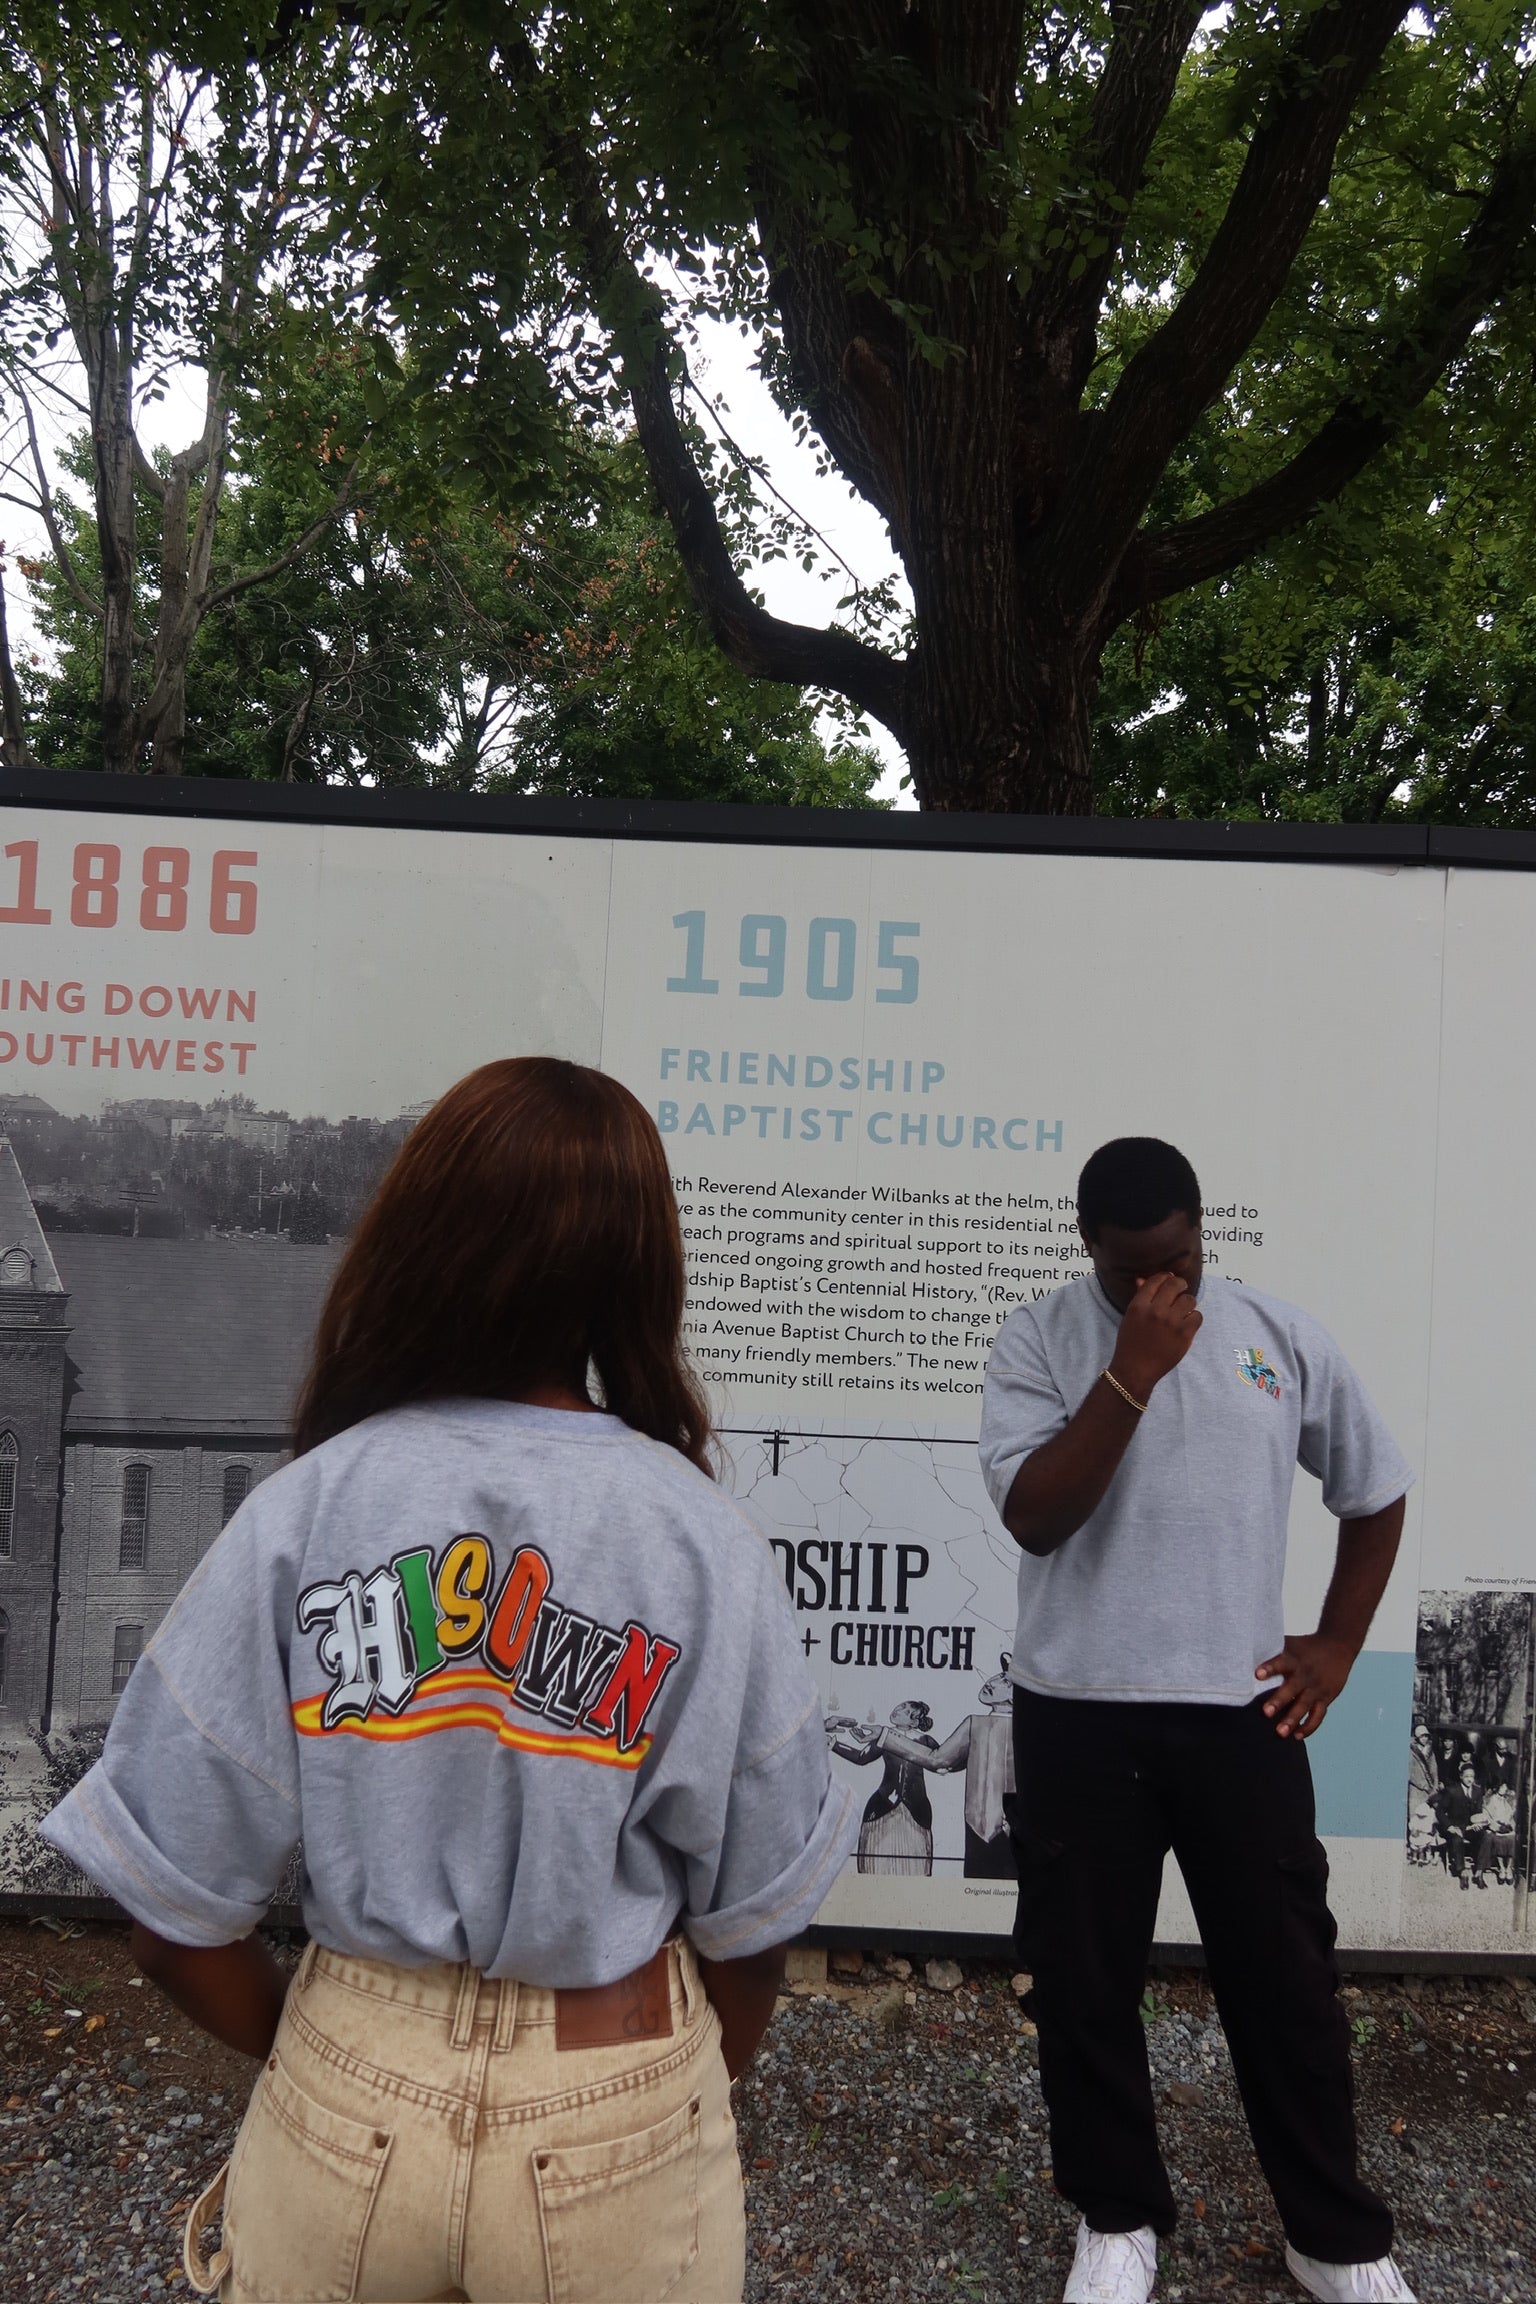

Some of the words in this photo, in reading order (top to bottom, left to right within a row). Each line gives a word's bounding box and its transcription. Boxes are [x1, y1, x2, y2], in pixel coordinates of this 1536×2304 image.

[0, 840, 258, 935] 1886
[666, 910, 921, 1004] 1905
[1, 979, 85, 1014] ING
[104, 984, 257, 1022] DOWN
[660, 1048, 945, 1093] FRIENDSHIP
[658, 1101, 853, 1142] BAPTIST
[867, 1111, 1064, 1152] CHURCH
[699, 1177, 776, 1196] Reverend
[781, 1182, 867, 1200] Alexander
[872, 1187, 949, 1205] Wilbanks
[955, 1194, 970, 1205] at
[976, 1192, 1002, 1207] the
[1008, 1193, 1053, 1211] helm,
[1242, 1206, 1258, 1218] to
[698, 1206, 715, 1216] as
[721, 1203, 747, 1217] the
[753, 1209, 846, 1226] community
[852, 1213, 903, 1225] center
[909, 1215, 923, 1226] in
[929, 1213, 959, 1228] this
[965, 1216, 1052, 1233] residential
[680, 1225, 721, 1240] each
[728, 1231, 804, 1247] programs
[810, 1232, 839, 1246] and
[845, 1234, 912, 1250] spiritual
[917, 1240, 981, 1255] support
[987, 1242, 1003, 1254] to
[1010, 1243, 1028, 1255] its
[755, 1255, 823, 1272] ongoing
[827, 1257, 884, 1273] growth
[890, 1259, 920, 1273] and
[926, 1260, 982, 1276] hosted
[988, 1263, 1059, 1281] frequent
[689, 1272, 734, 1291] dship
[741, 1274, 811, 1293] Baptist's
[817, 1278, 906, 1297] Centennial
[913, 1282, 977, 1303] History,
[685, 1297, 762, 1313] endowed
[767, 1301, 803, 1316] with
[809, 1302, 835, 1317] the
[840, 1304, 904, 1320] wisdom
[910, 1309, 926, 1321] to
[932, 1308, 990, 1327] change
[712, 1320, 775, 1337] Avenue
[782, 1323, 839, 1342] Baptist
[845, 1326, 904, 1343] Church
[910, 1332, 926, 1345] to
[932, 1331, 959, 1346] the
[696, 1347, 741, 1362] many
[746, 1345, 811, 1366] friendly
[816, 1351, 902, 1366] members."
[907, 1353, 939, 1369] The
[944, 1360, 978, 1370] new
[703, 1371, 797, 1389] community
[803, 1373, 833, 1388] still
[839, 1376, 894, 1390] retains
[901, 1377, 919, 1391] its
[1464, 1576, 1484, 1584] Photo
[831, 1622, 976, 1670] CHURCH
[964, 1887, 992, 1896] Original
